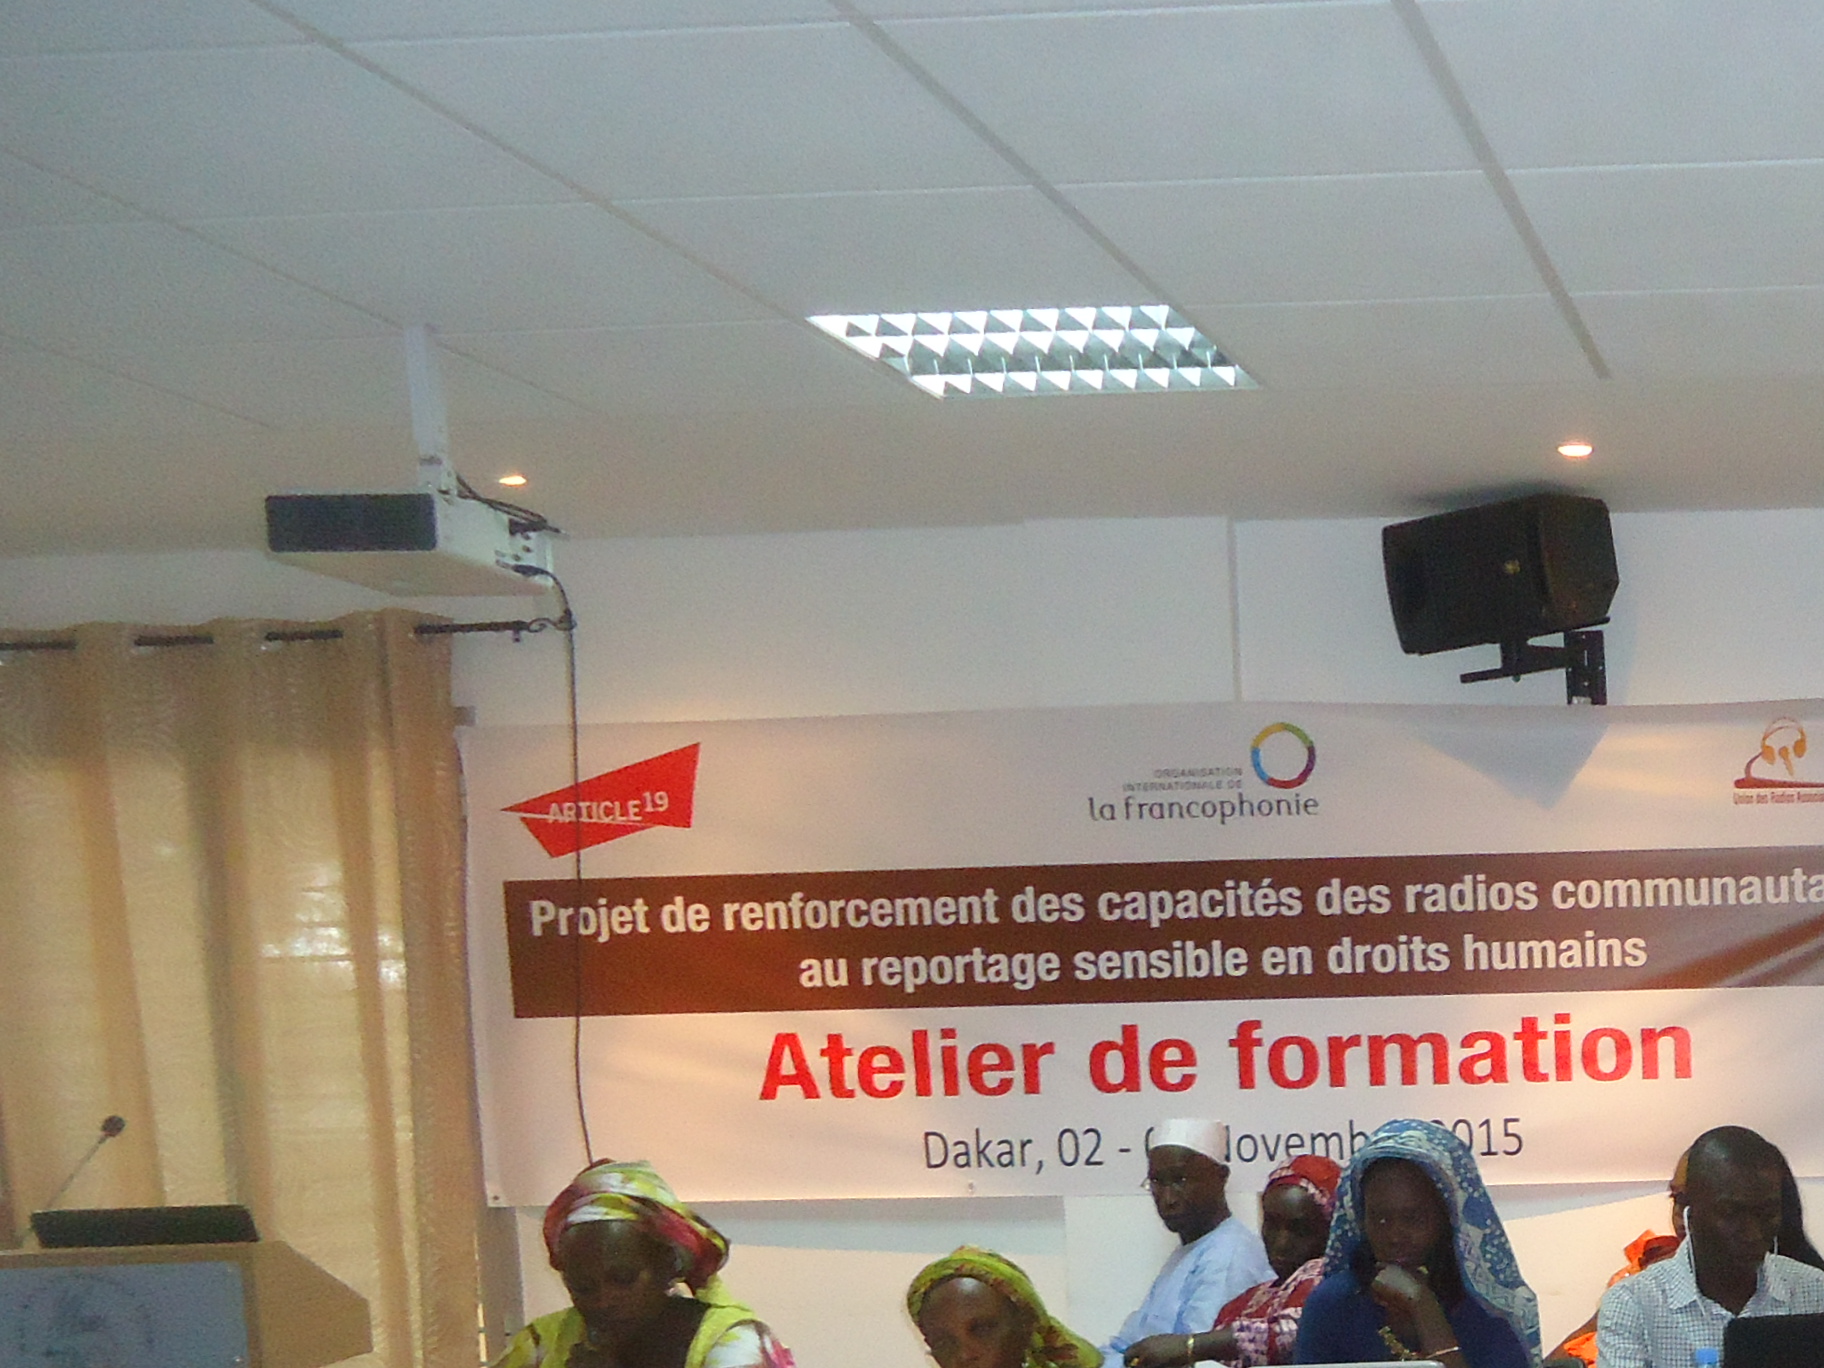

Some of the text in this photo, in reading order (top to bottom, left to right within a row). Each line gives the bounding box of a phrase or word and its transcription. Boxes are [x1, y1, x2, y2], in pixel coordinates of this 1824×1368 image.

[1227, 778, 1242, 789] DE
[549, 792, 669, 823] ARTICLE 19
[1088, 792, 1319, 825] la francophonie
[531, 897, 649, 944] Projet
[660, 896, 710, 933] de
[723, 886, 999, 932] renforcement
[1011, 885, 1084, 924] des
[1098, 878, 1302, 928] capacités
[1316, 877, 1391, 916] des
[1404, 872, 1539, 913] radios
[800, 930, 1648, 992] au reportage sensible en droits humains
[759, 1011, 1694, 1100] Atelier de formation
[925, 1128, 1044, 1173] Dakar,
[1057, 1127, 1104, 1168] 02
